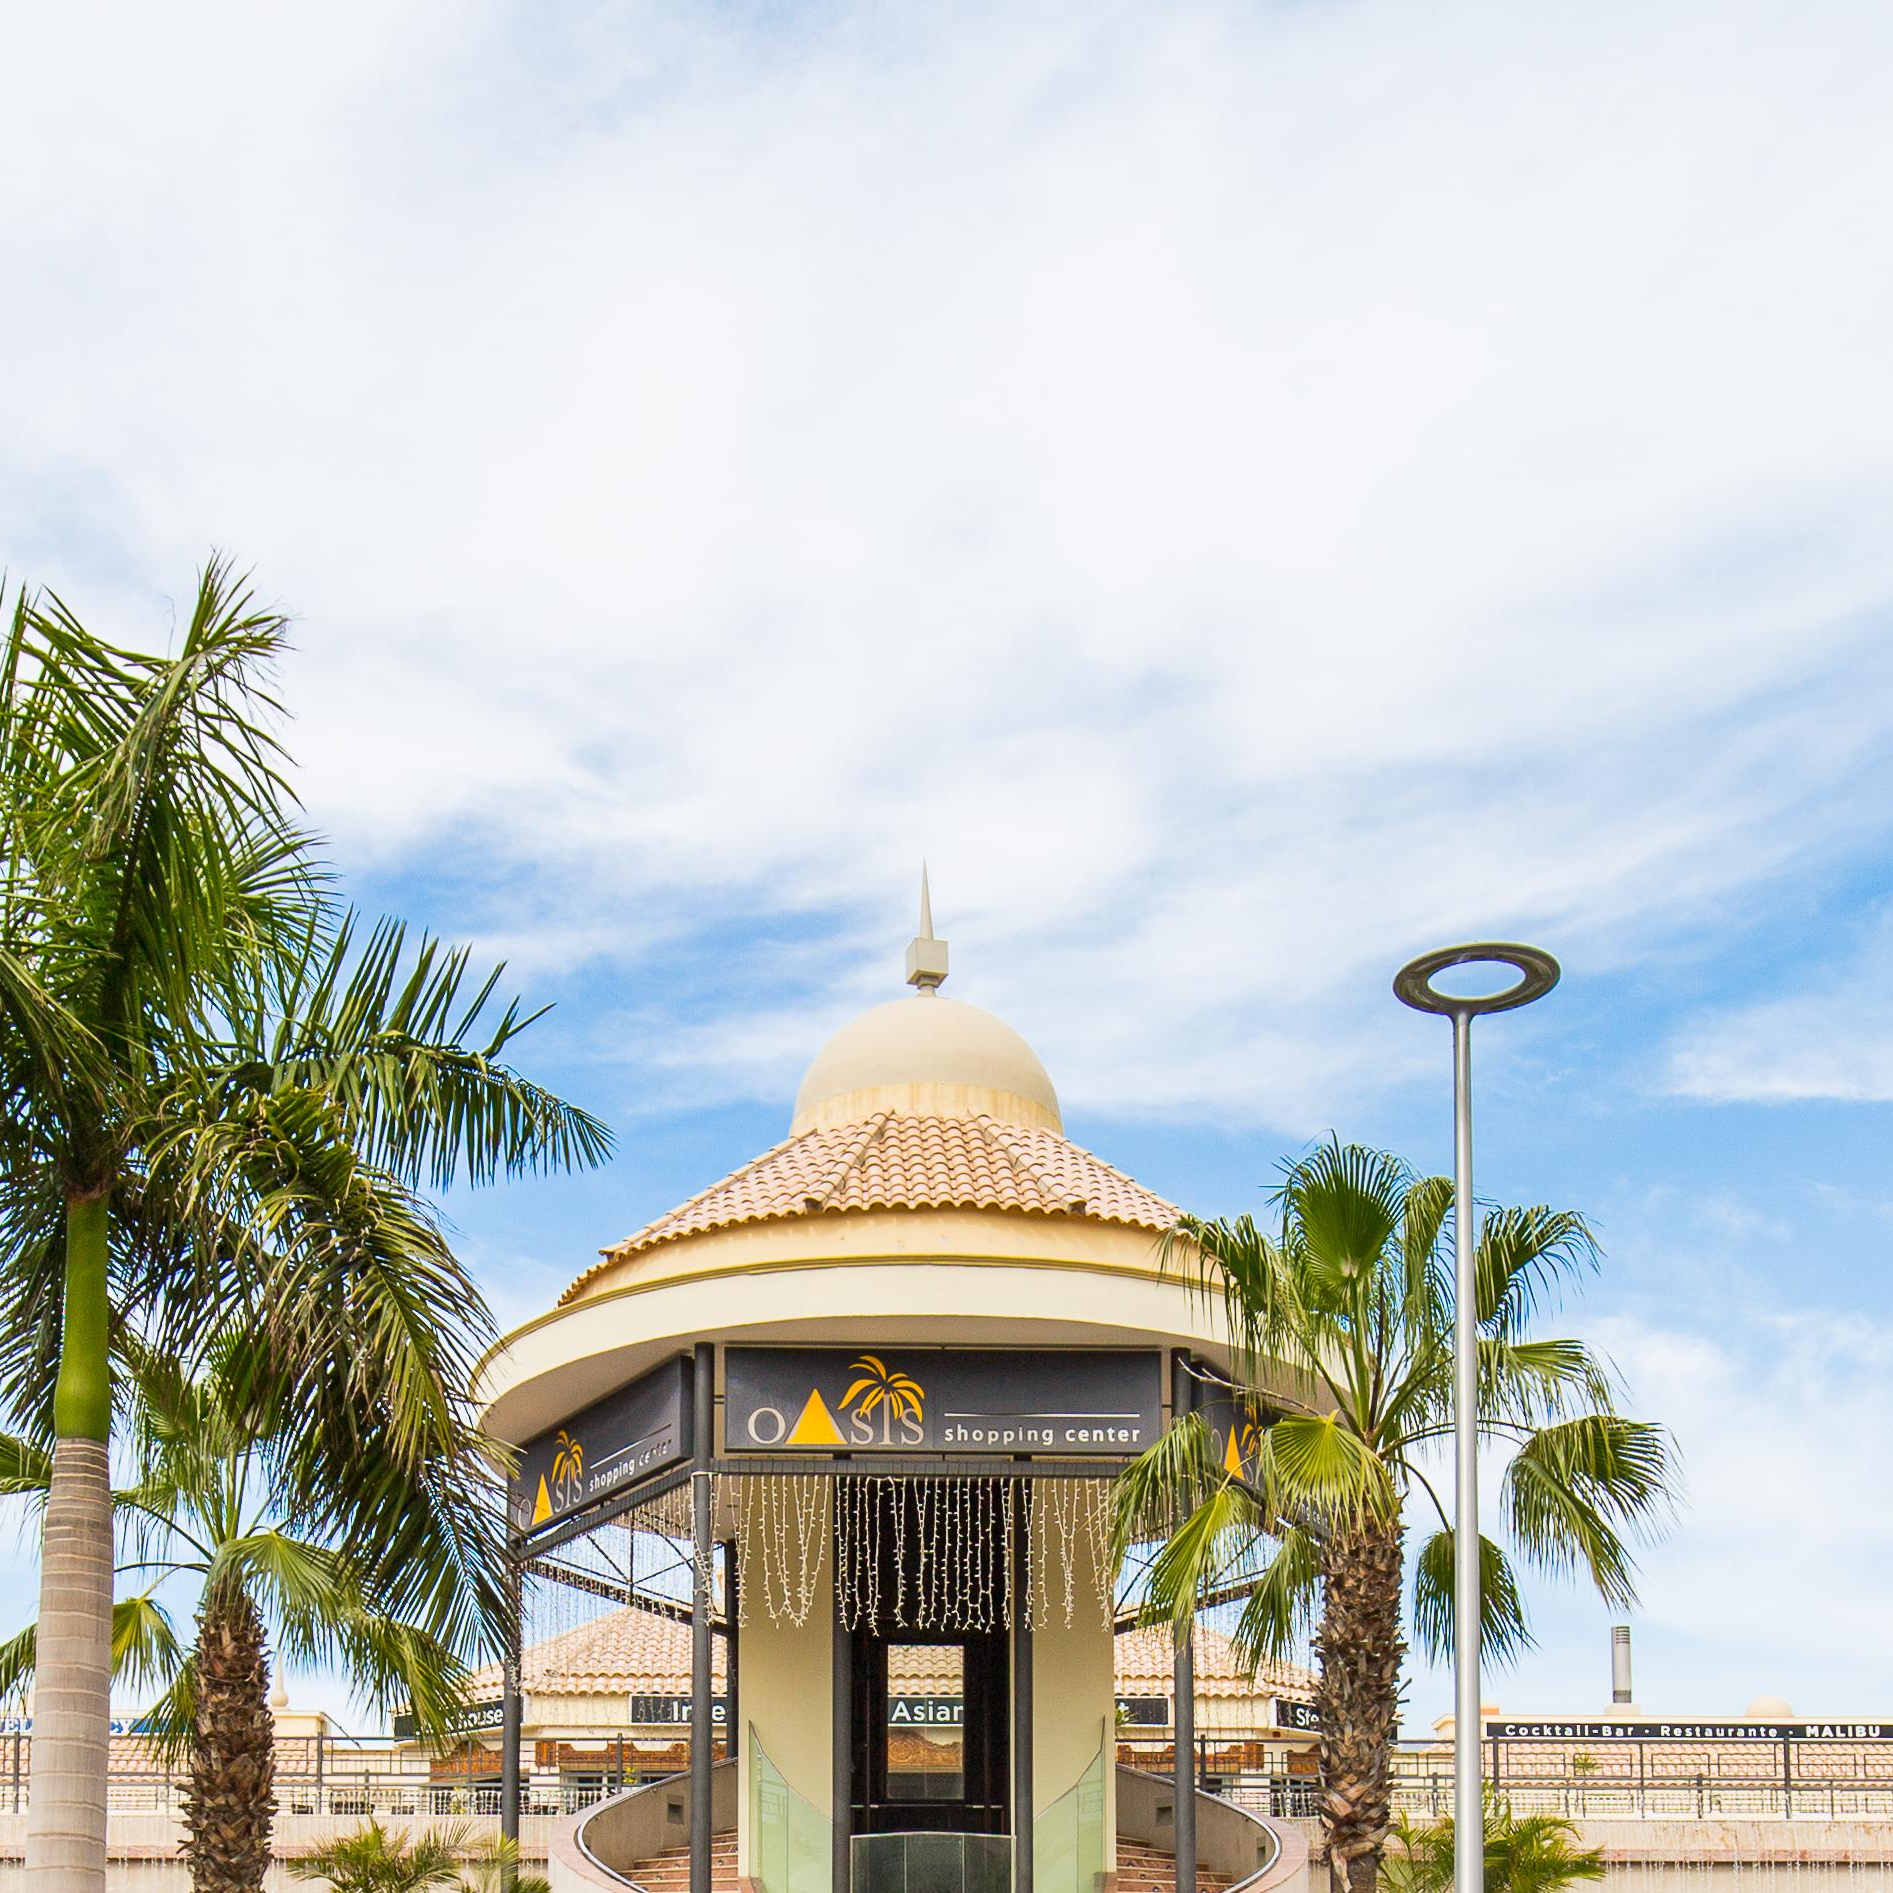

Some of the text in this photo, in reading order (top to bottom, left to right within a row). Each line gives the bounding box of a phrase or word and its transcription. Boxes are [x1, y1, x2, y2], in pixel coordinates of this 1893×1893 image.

[944, 1424, 1054, 1446] shopping
[1064, 1427, 1141, 1444] center
[589, 1458, 636, 1493] shopping
[1660, 1725, 1779, 1737] Restaurante
[1806, 1725, 1882, 1738] MALIBU
